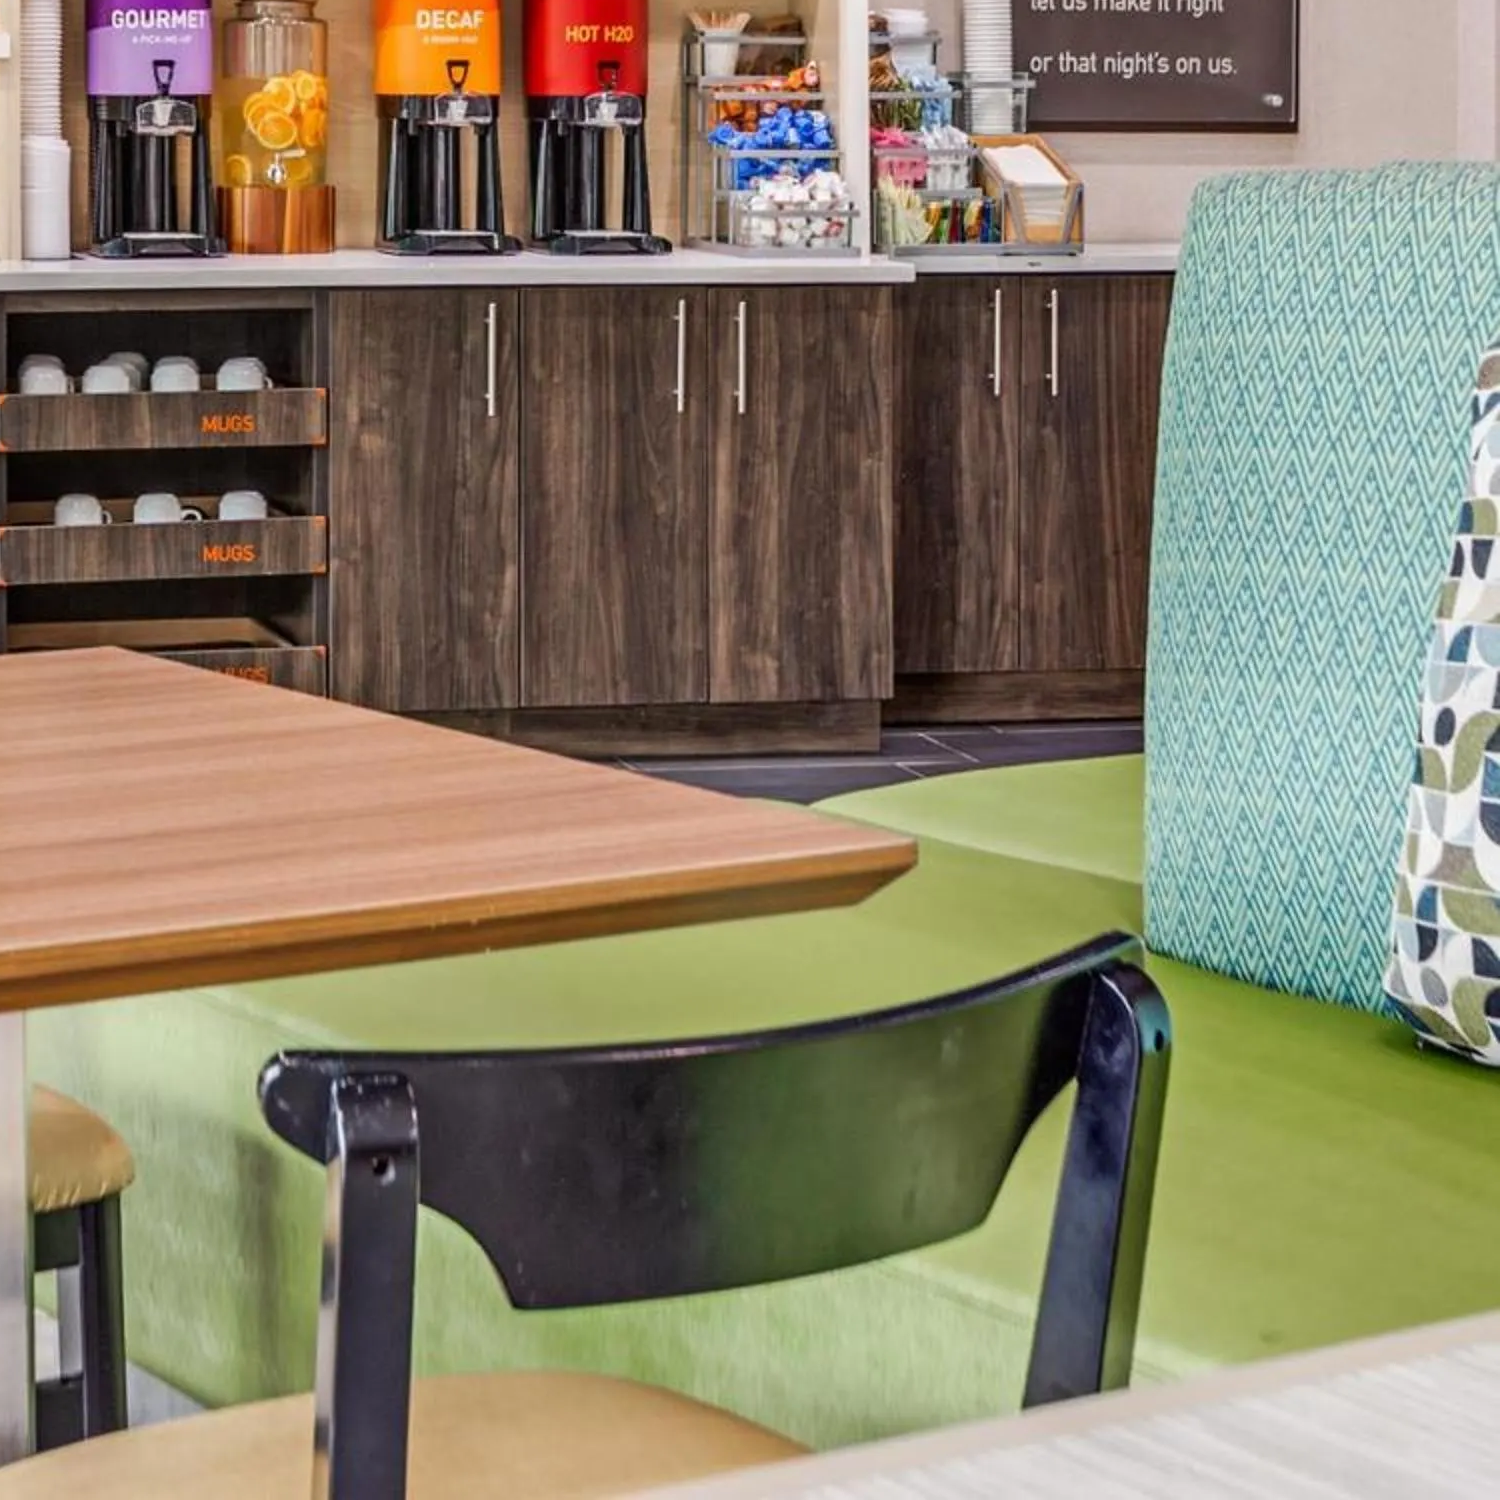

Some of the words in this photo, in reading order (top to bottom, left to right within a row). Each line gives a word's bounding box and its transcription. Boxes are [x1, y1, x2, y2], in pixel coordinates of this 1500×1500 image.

[111, 8, 206, 29] GOURMET
[415, 8, 485, 29] DECAF
[565, 25, 600, 43] HOT
[1030, 55, 1053, 74] or
[1058, 51, 1097, 74] that
[1103, 51, 1170, 79] night's
[1175, 56, 1202, 75] on
[1208, 57, 1238, 75] us.
[202, 414, 256, 434] MUGS
[202, 543, 256, 562] MUGS
